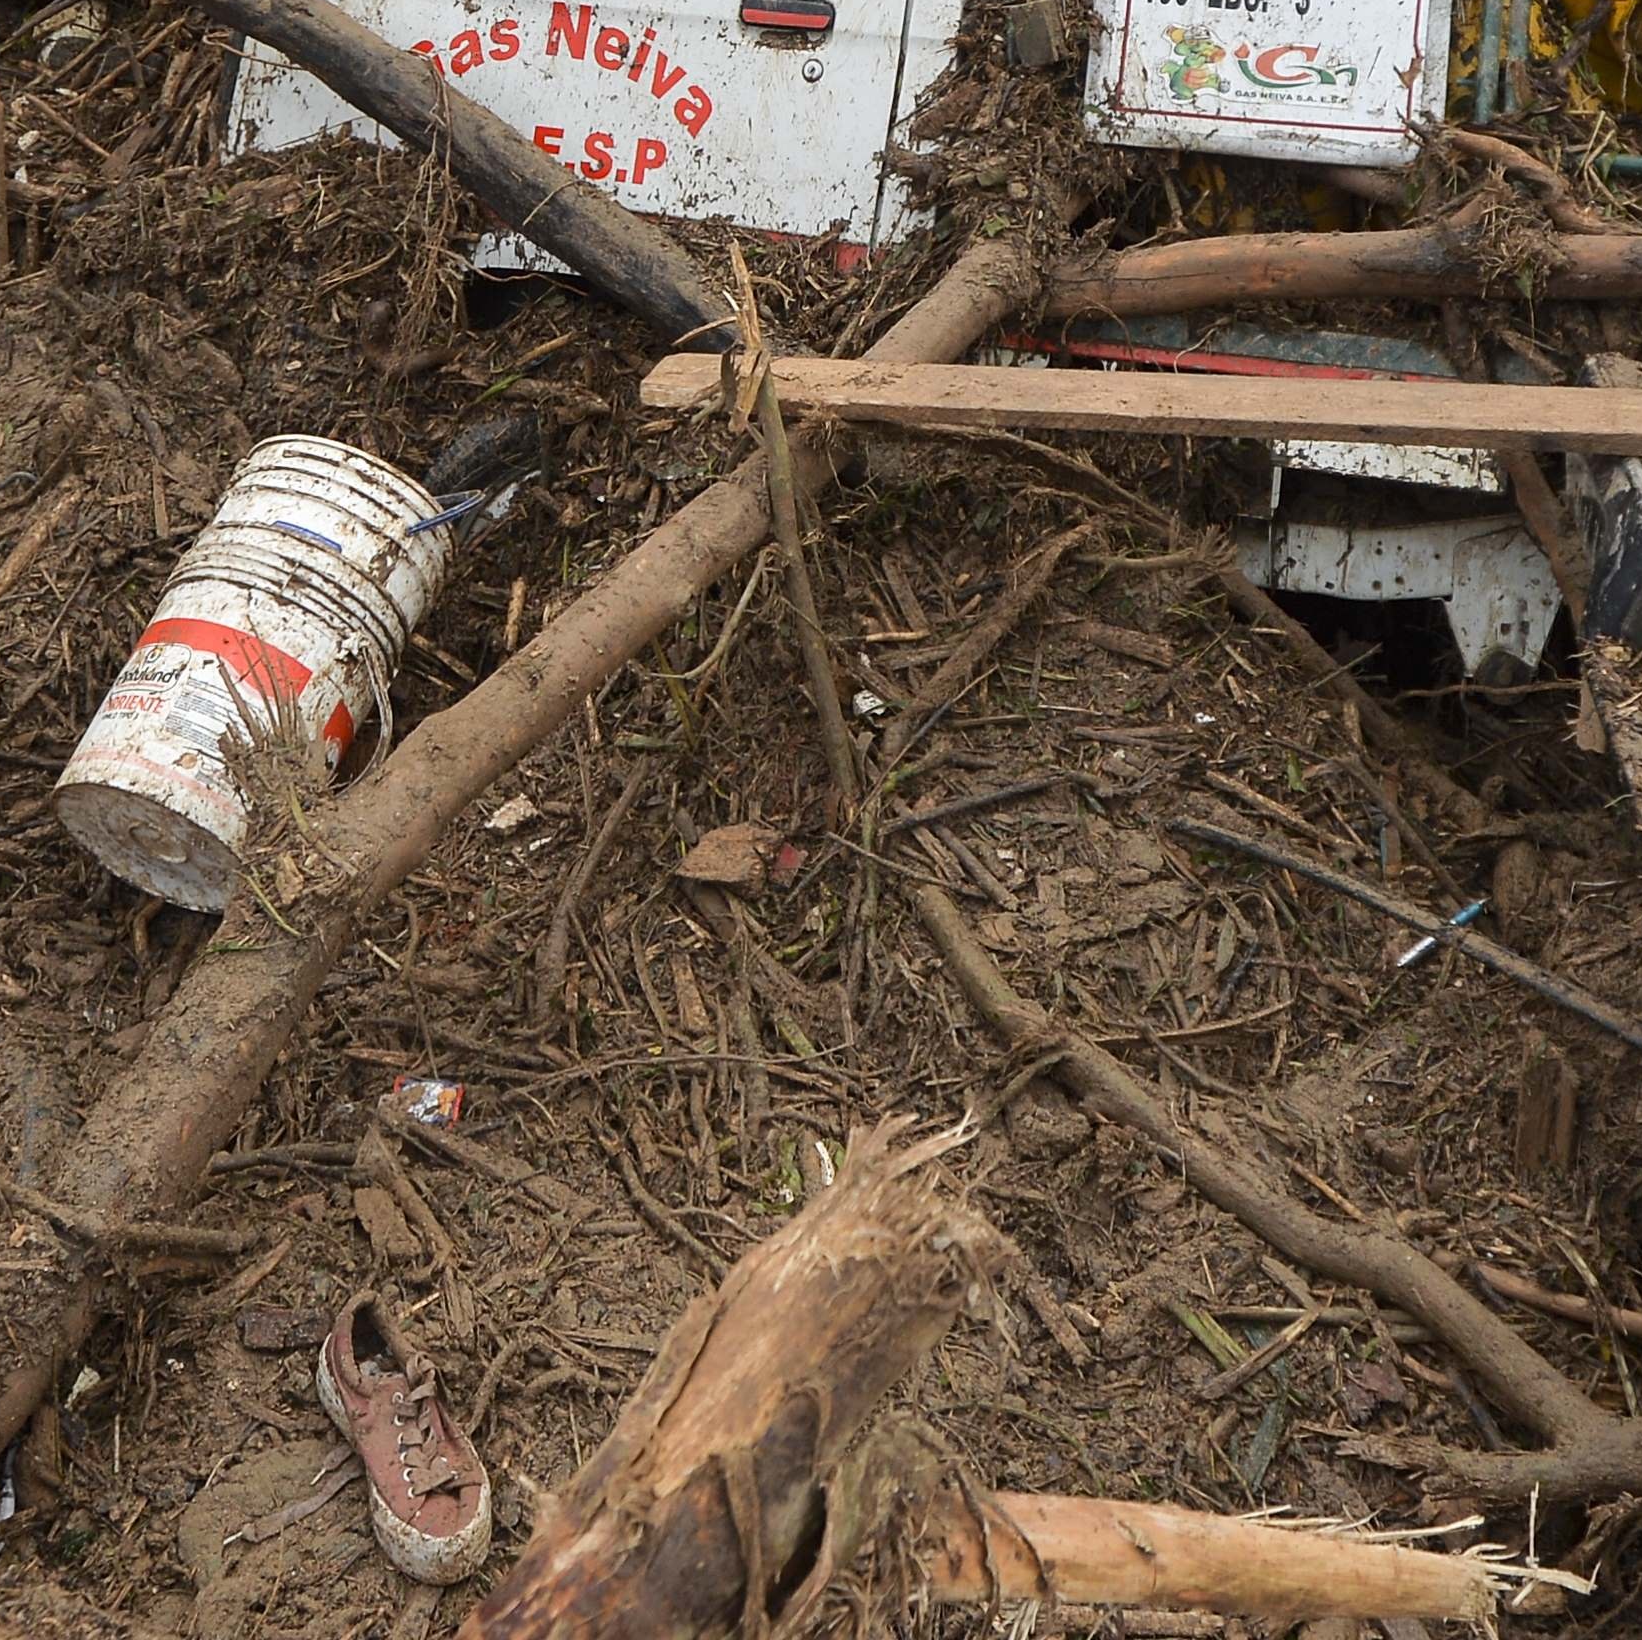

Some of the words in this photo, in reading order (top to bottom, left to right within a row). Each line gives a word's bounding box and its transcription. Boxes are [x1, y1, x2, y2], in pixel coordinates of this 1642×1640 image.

[545, 1, 713, 139] Neiva
[1235, 90, 1257, 98] GAS
[1260, 91, 1293, 101] NEIVA
